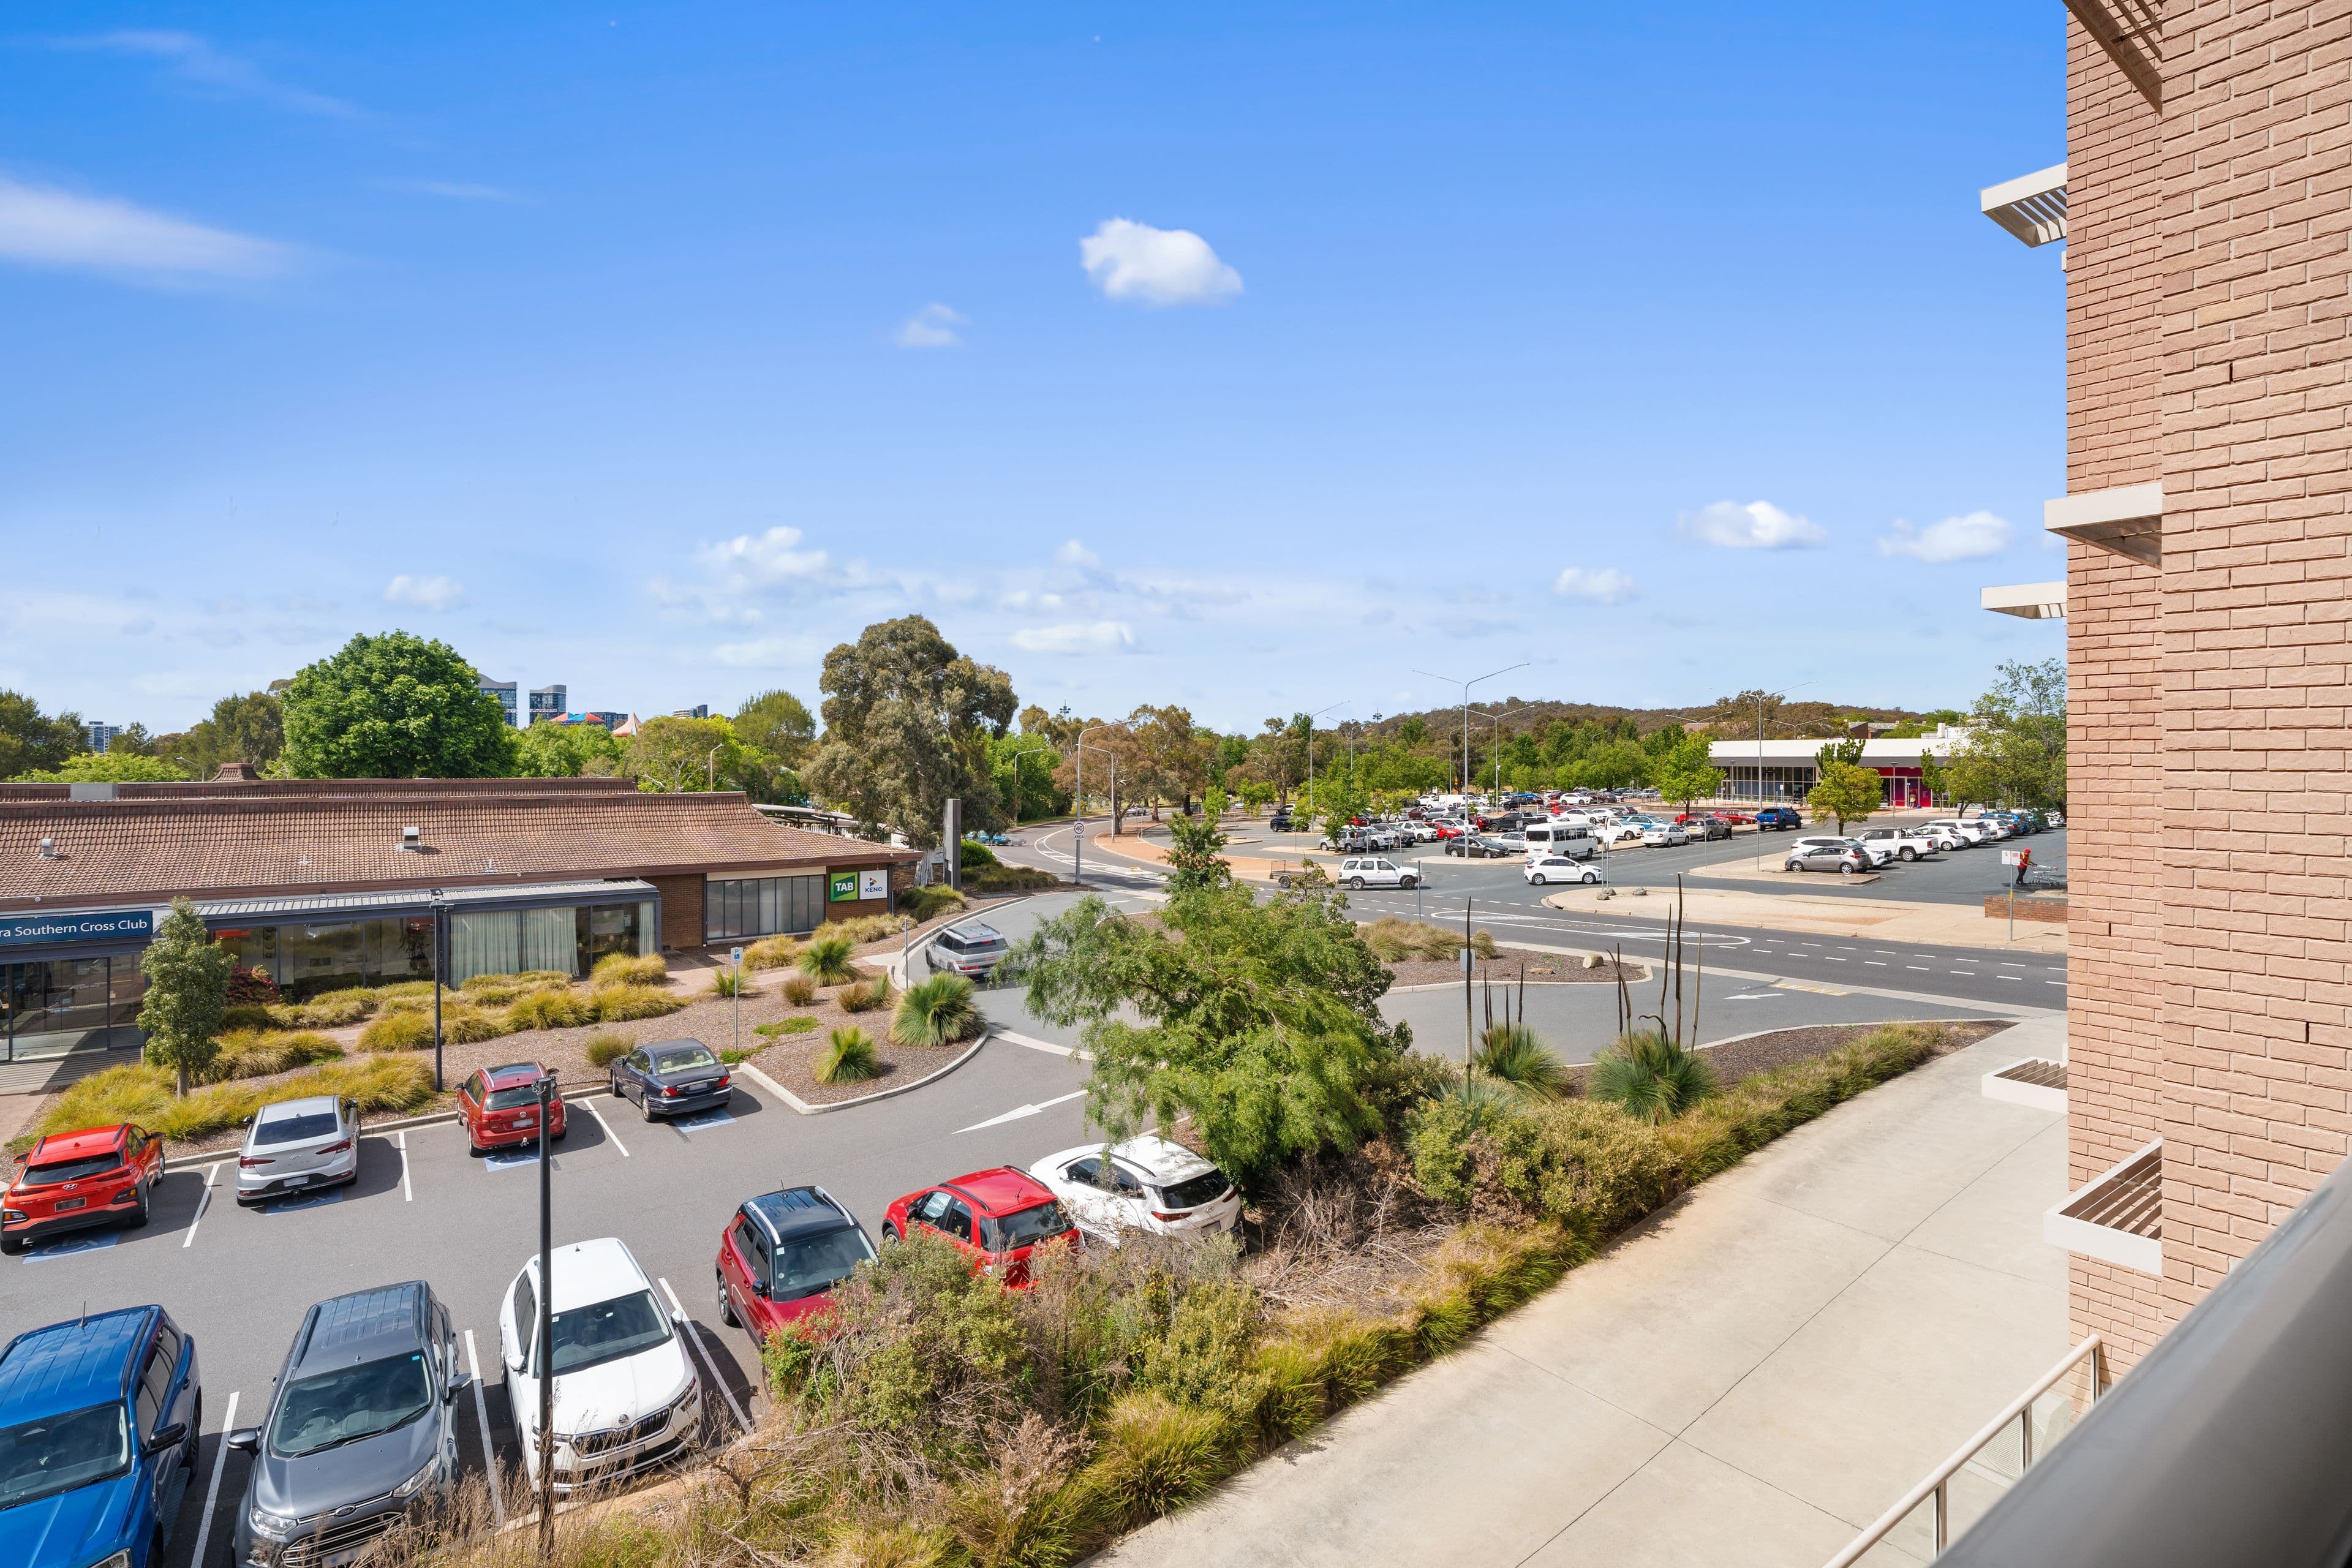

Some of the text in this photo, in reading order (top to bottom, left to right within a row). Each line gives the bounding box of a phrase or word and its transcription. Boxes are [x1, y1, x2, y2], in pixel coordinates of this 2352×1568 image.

[835, 882, 854, 892] TAB
[15, 924, 77, 937] Southern
[80, 922, 115, 932] Cross
[118, 919, 148, 930] Club
